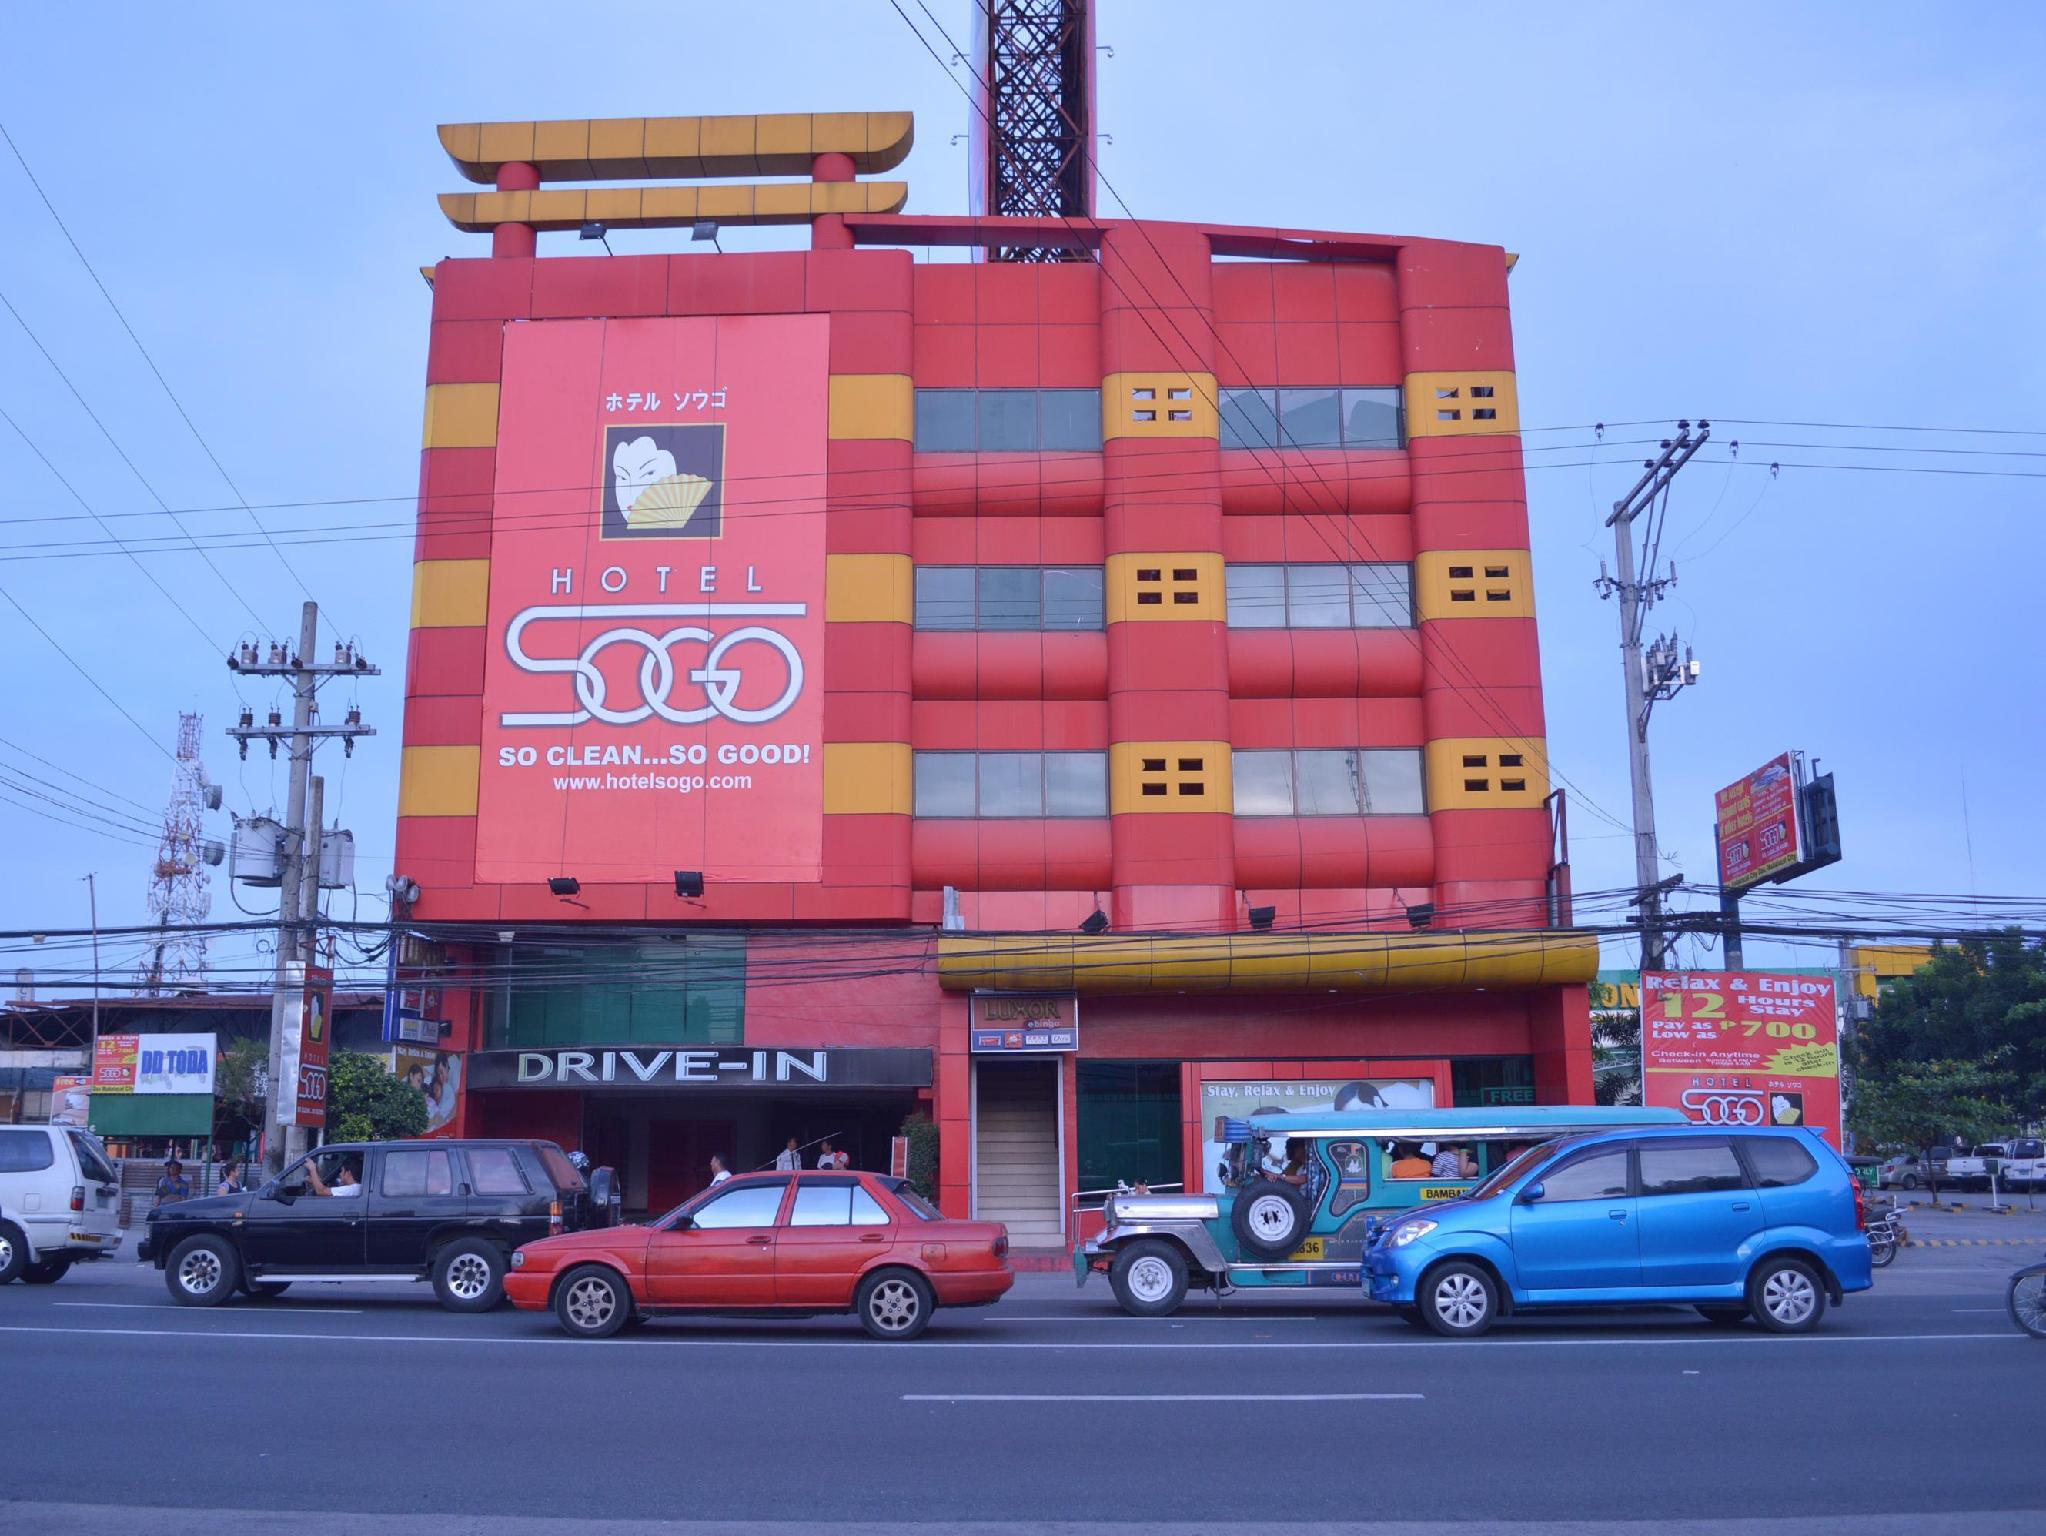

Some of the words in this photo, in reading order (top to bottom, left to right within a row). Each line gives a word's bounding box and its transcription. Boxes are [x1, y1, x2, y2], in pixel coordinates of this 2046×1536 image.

[605, 392, 661, 412] ホテル
[673, 384, 728, 411] ソウゴ
[551, 566, 762, 594] HOTEL
[500, 602, 807, 726] SOGO
[499, 746, 538, 766] SO
[717, 744, 810, 764] GOOD!
[553, 773, 752, 793] www.hotelsogo.com
[1646, 975, 1720, 990] Relax
[1730, 978, 1748, 991] &
[1759, 978, 1831, 997] Enjoy
[984, 999, 1061, 1020] LUXOR
[1663, 992, 1726, 1018] 12
[1738, 995, 1815, 1007] Hours
[1750, 1006, 1805, 1017] Stay
[1653, 1021, 1685, 1030] Pay
[1692, 1022, 1712, 1030] as
[1653, 1030, 1689, 1039] Low
[1696, 1031, 1719, 1039] as
[166, 1050, 209, 1074] TODA
[517, 1051, 827, 1082] DRIVE-IN
[299, 1063, 327, 1100] SOGO
[1208, 1084, 1239, 1098] Stay,
[1244, 1084, 1280, 1097] Relax
[1285, 1085, 1295, 1096] &
[1299, 1084, 1337, 1098] Enjoy
[1692, 1077, 1752, 1087] HOTEL
[1491, 1089, 1534, 1102] FREE
[1682, 1088, 1764, 1126] SOGO
